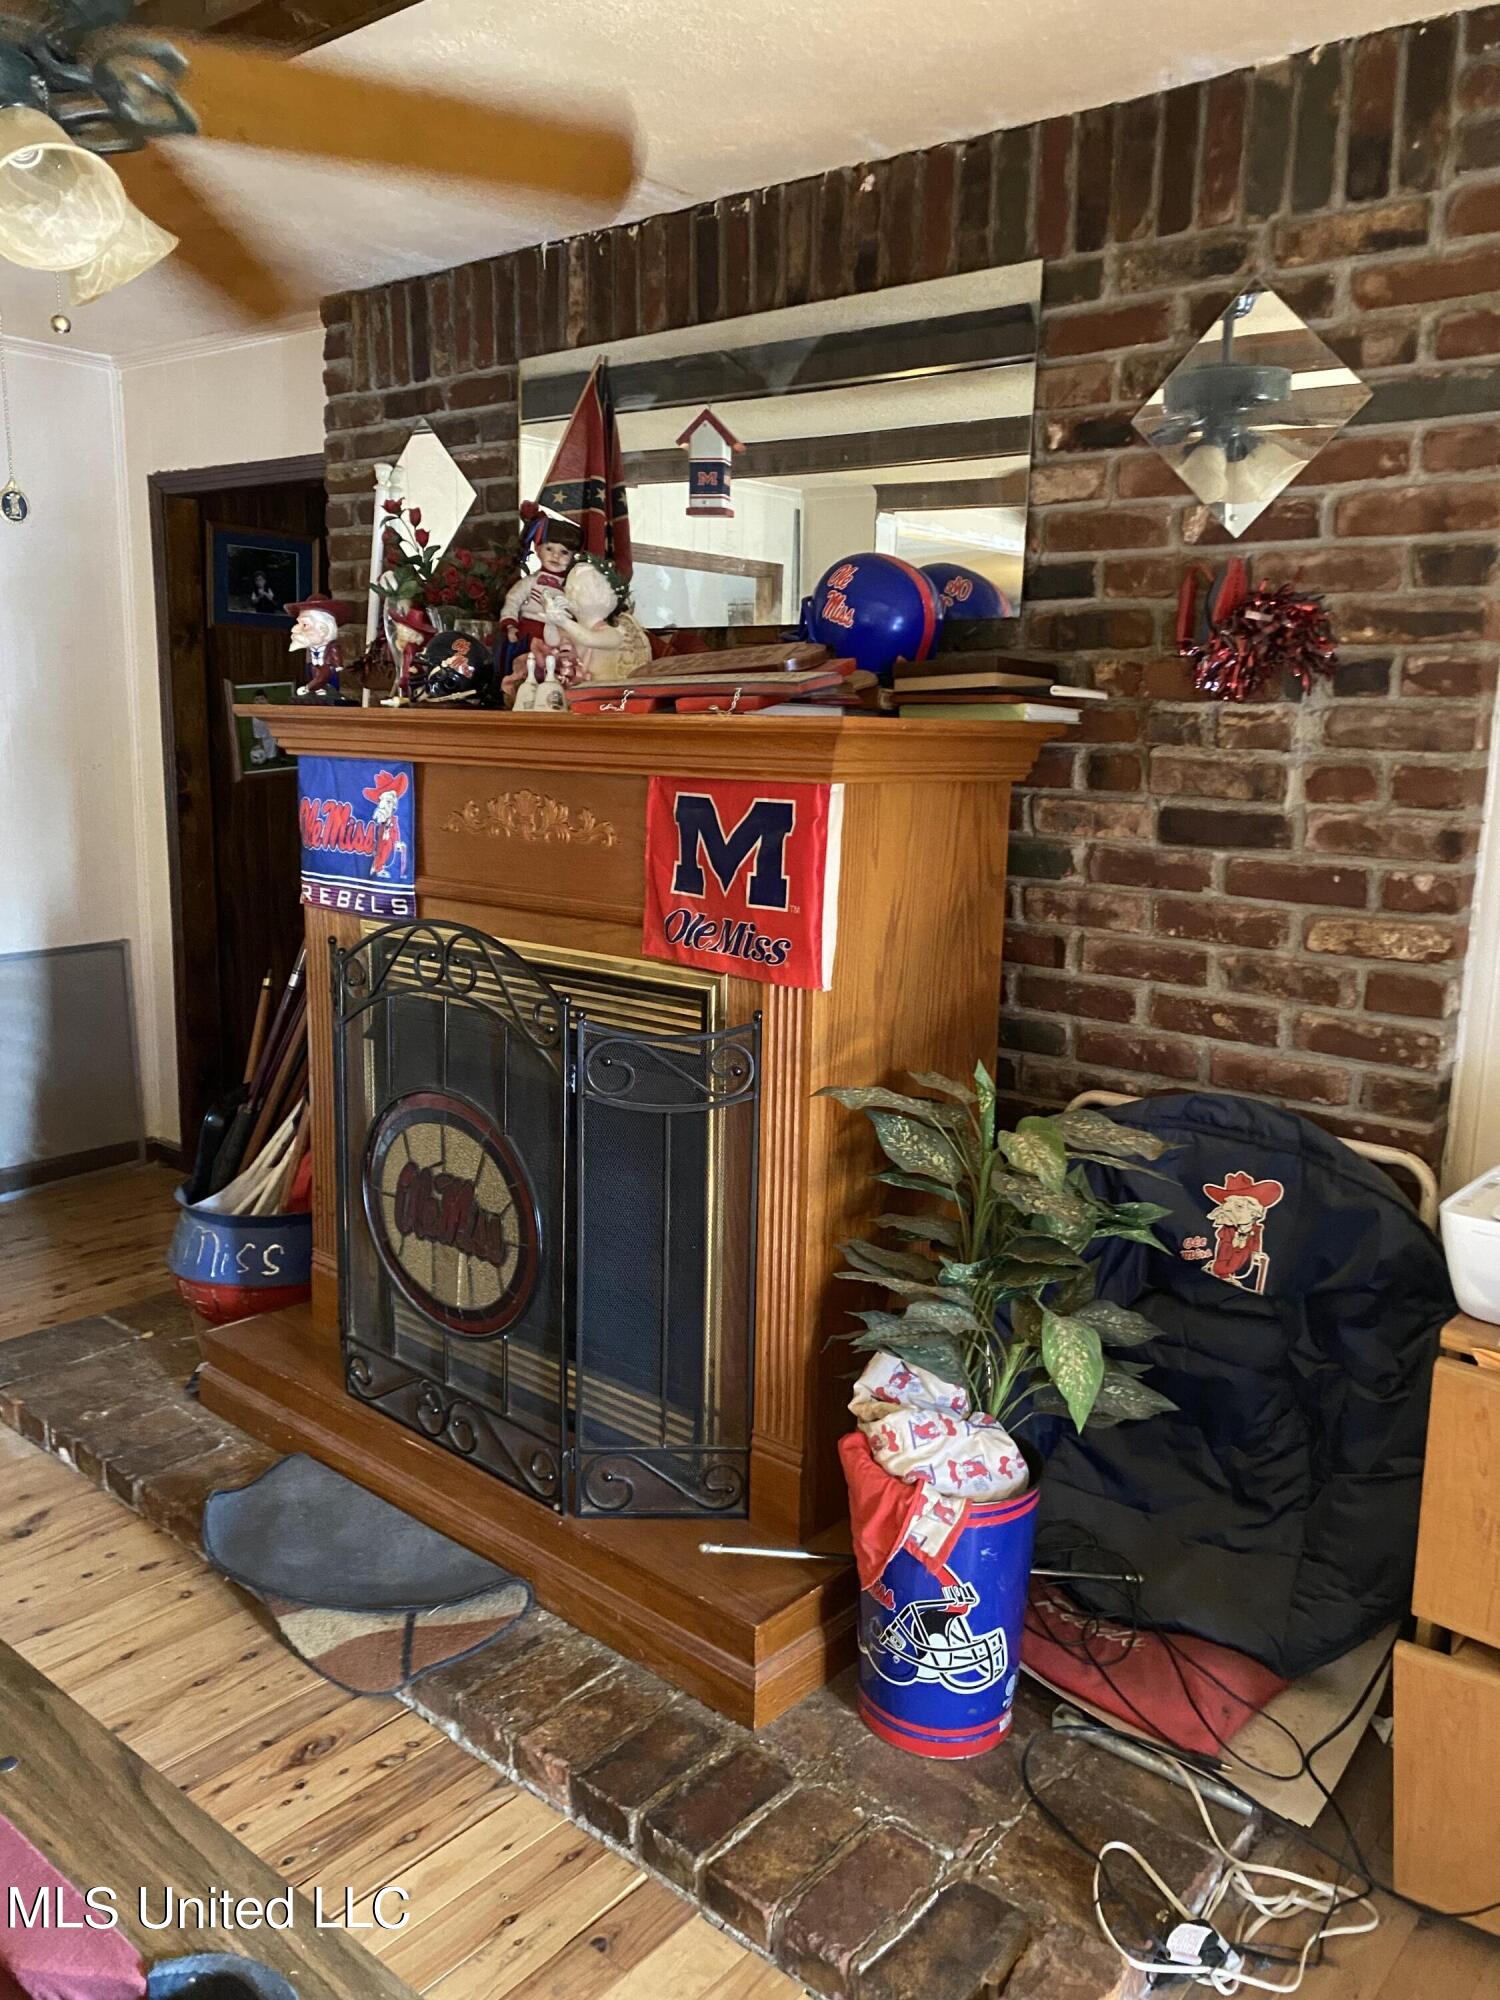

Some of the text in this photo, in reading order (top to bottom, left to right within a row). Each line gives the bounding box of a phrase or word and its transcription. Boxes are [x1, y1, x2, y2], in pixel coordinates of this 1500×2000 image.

[697, 471, 718, 486] M
[827, 564, 859, 590] Ole
[822, 590, 855, 628] Miss
[321, 799, 376, 857] Miss
[670, 791, 796, 912] M
[300, 884, 408, 916] REBELS
[664, 907, 793, 967] Ole Miss
